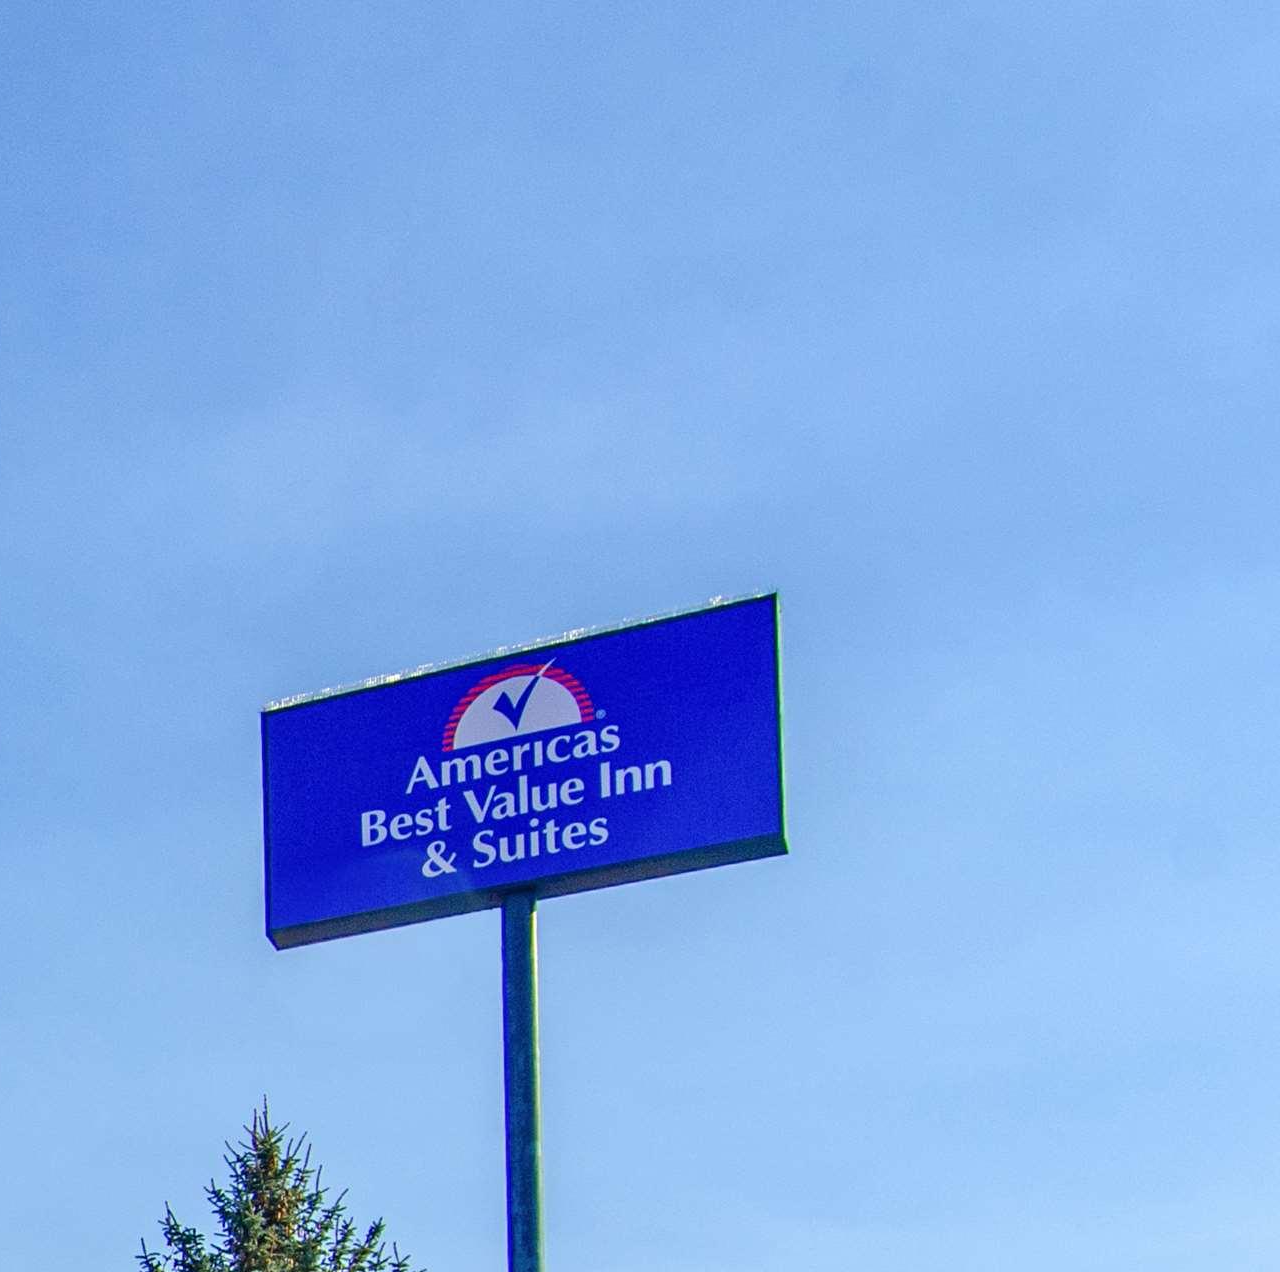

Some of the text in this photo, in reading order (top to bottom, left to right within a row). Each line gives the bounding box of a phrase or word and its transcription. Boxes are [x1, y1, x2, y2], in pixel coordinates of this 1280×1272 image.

[405, 725, 621, 795] Americas
[361, 759, 672, 847] Best Value Inn
[422, 817, 609, 878] & Suites
